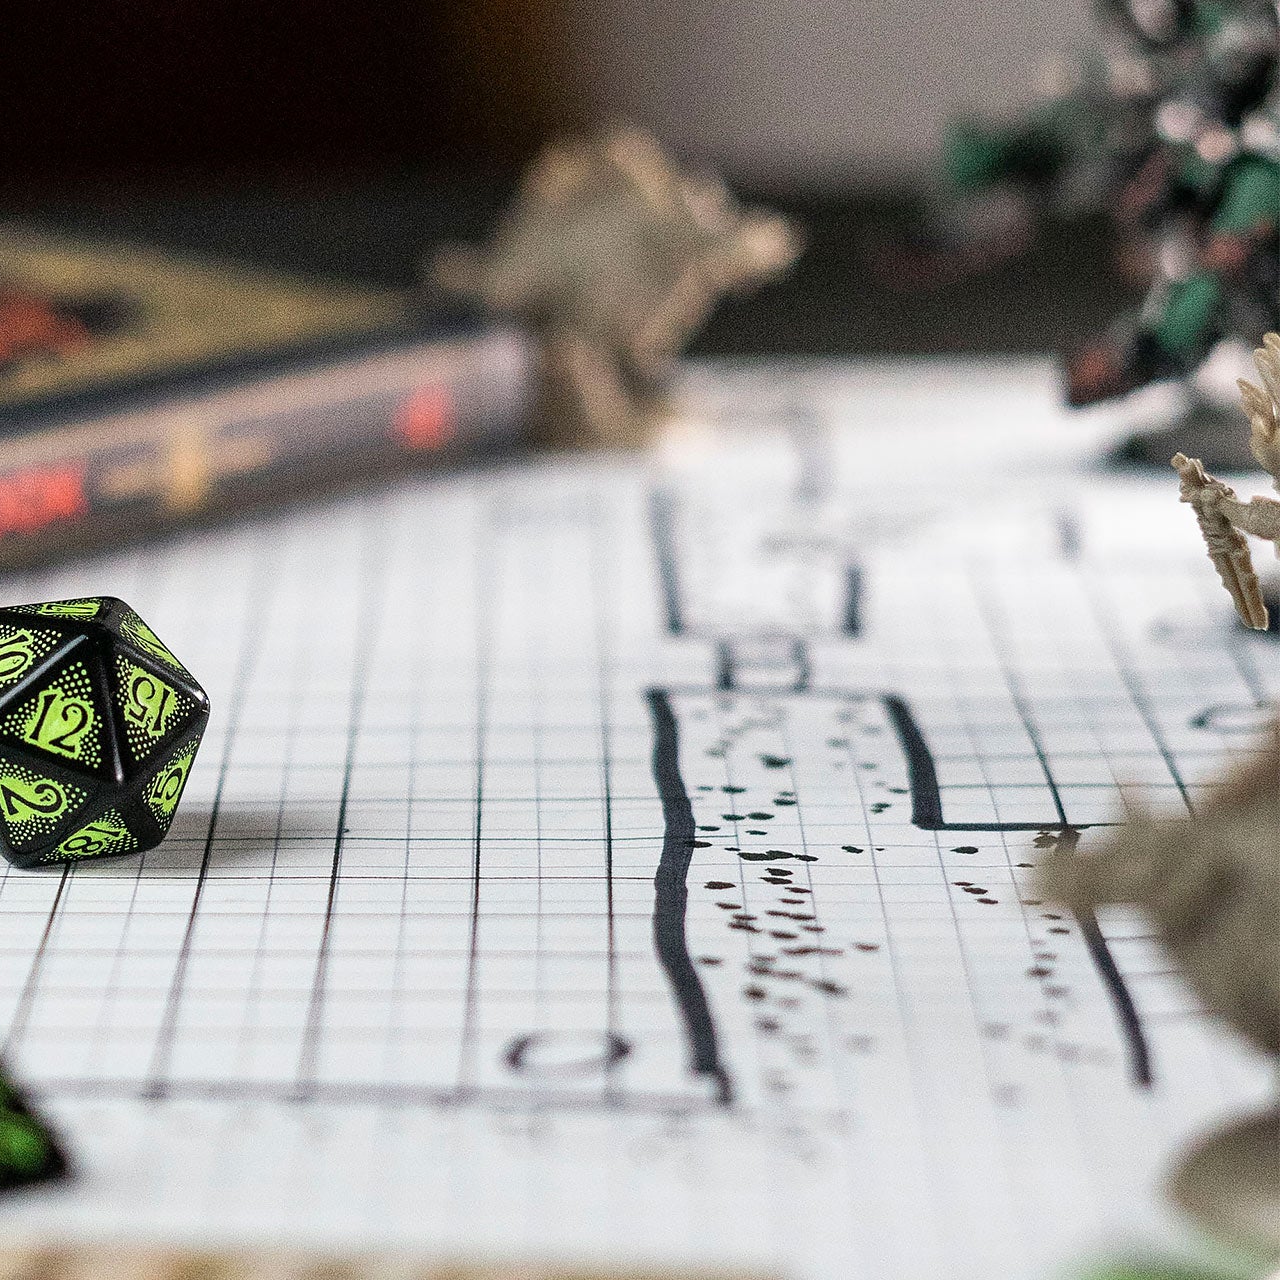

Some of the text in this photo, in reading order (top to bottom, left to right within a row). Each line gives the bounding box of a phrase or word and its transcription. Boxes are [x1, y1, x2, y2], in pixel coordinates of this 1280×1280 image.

[128, 676, 170, 733] 15
[29, 694, 89, 752] 12
[0, 782, 63, 817] 2
[154, 767, 184, 800] 5
[63, 825, 122, 853] 18
